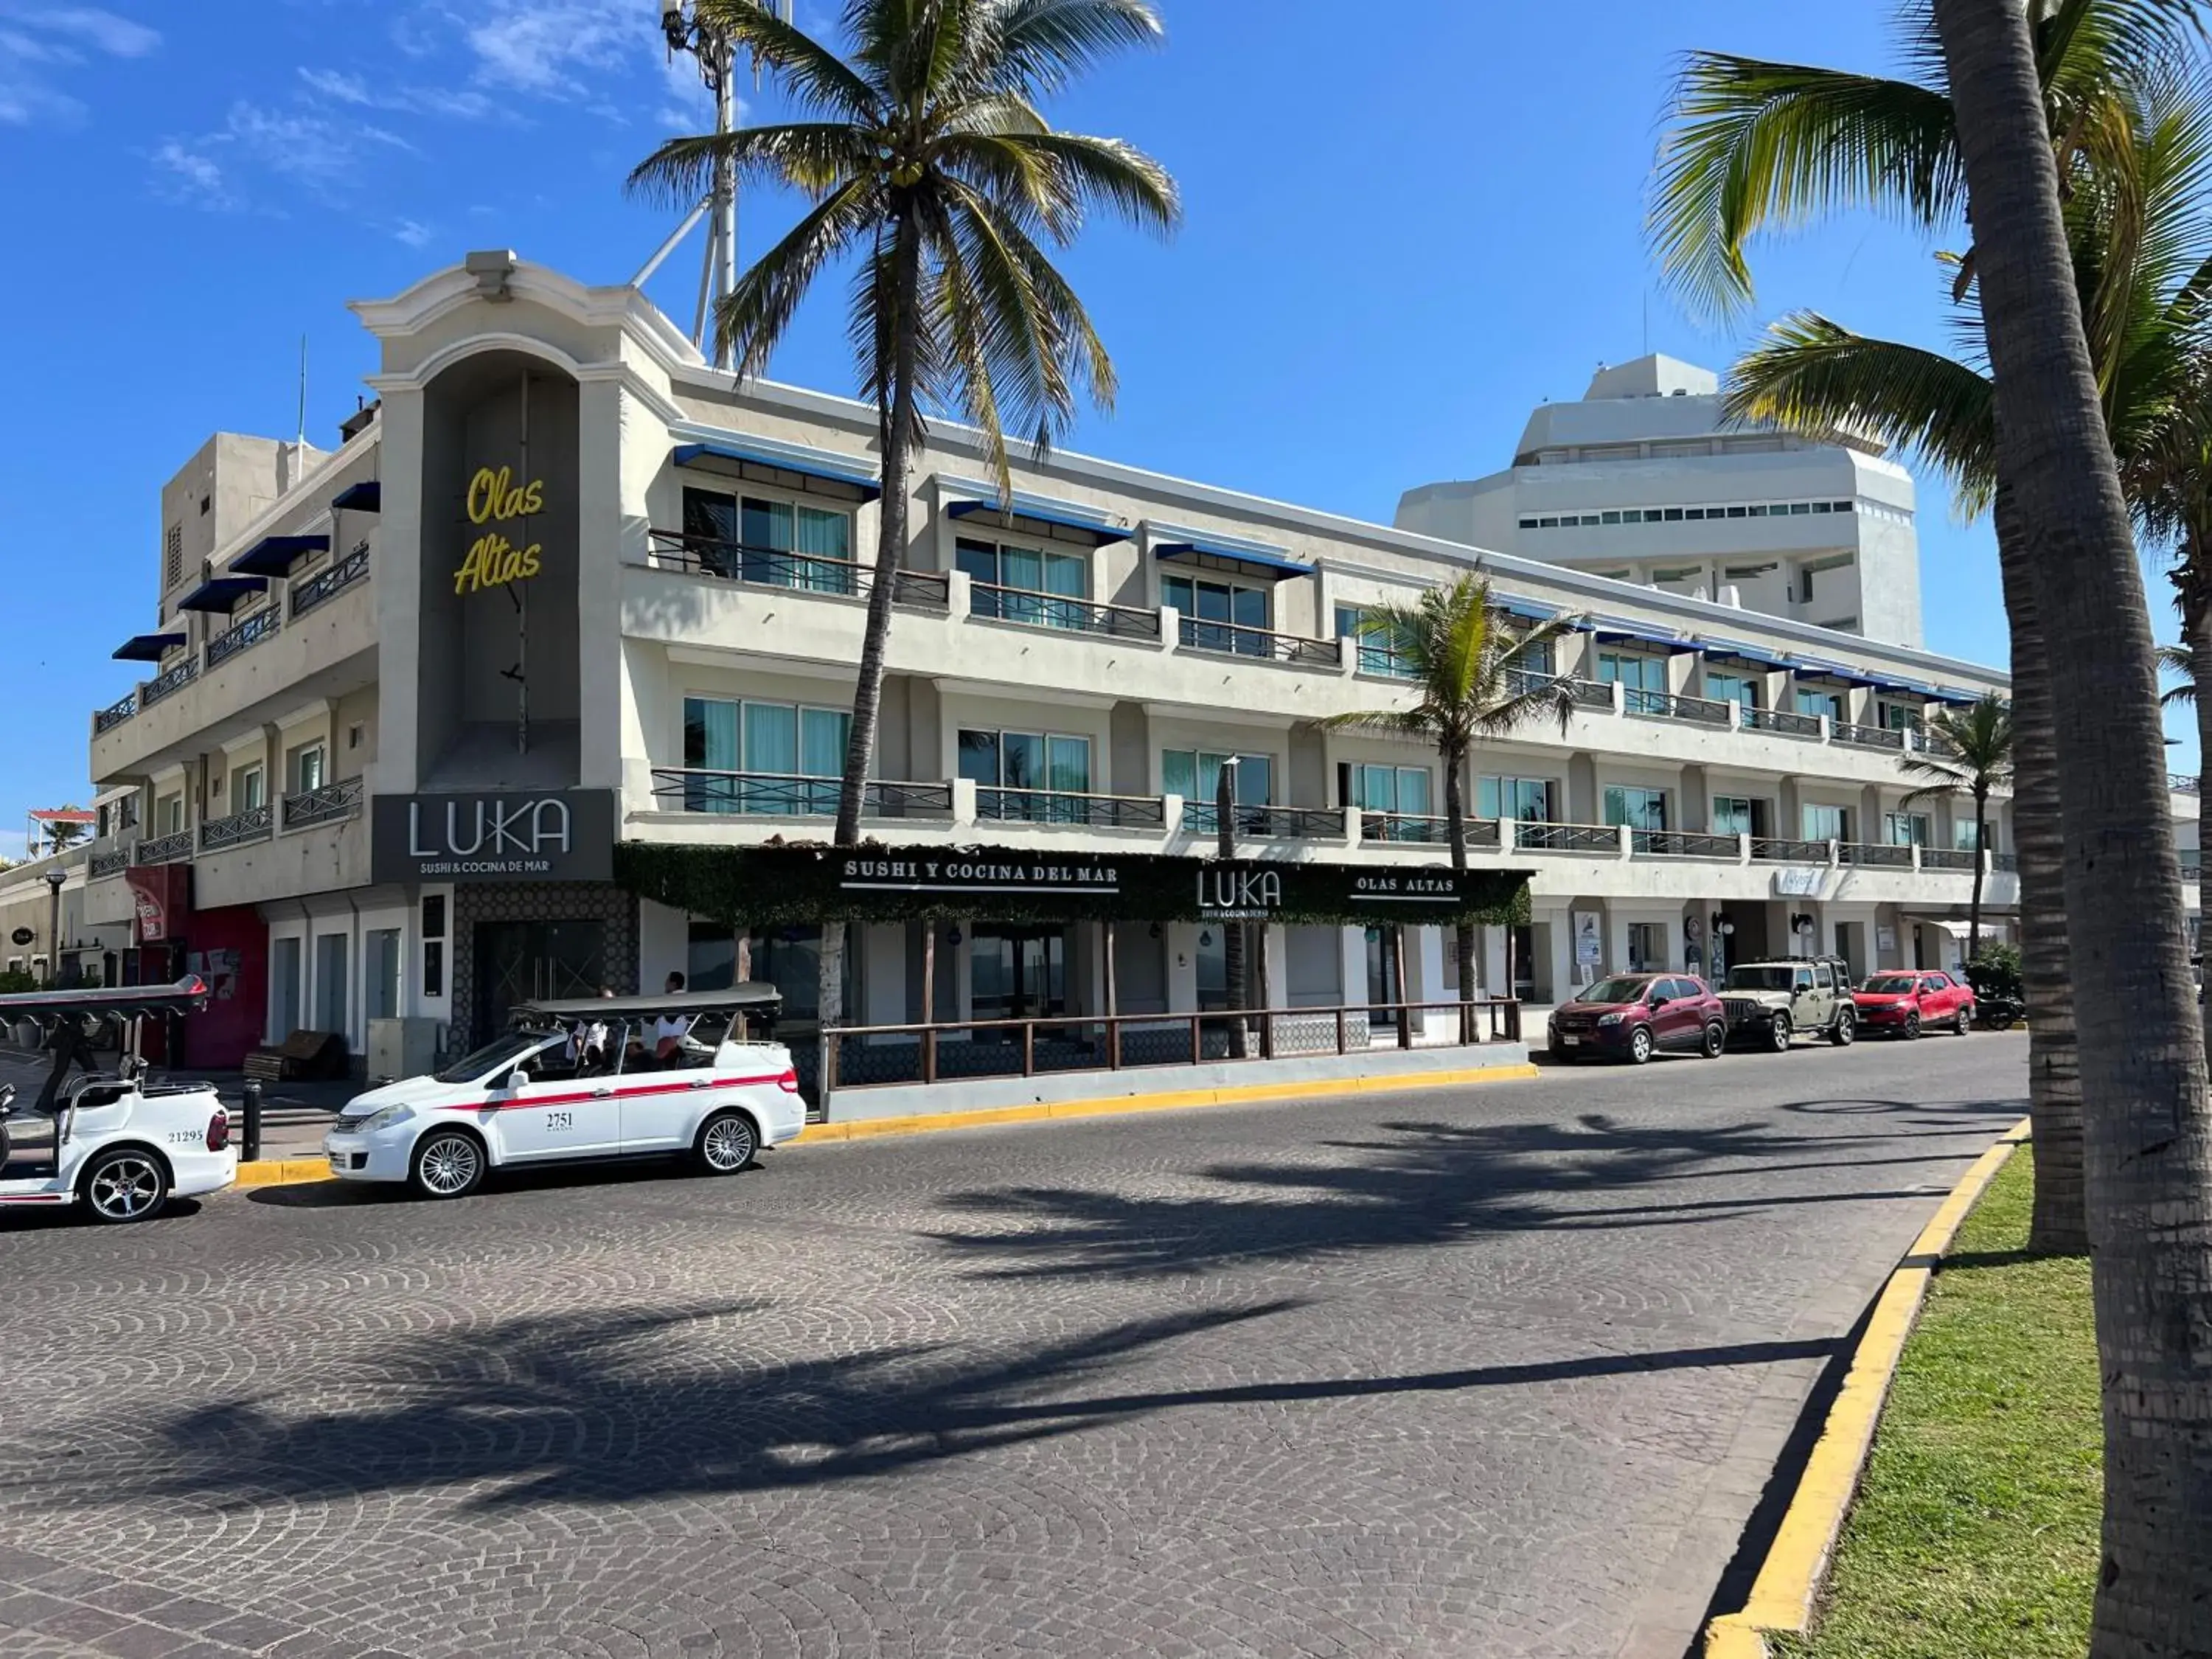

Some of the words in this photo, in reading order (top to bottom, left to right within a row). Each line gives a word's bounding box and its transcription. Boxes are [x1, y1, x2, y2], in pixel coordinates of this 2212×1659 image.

[467, 465, 544, 524] Olas
[453, 532, 542, 594] Altas
[409, 799, 571, 857] LUKA
[420, 863, 451, 874] SUSHI
[452, 863, 461, 873] &
[462, 861, 507, 873] COCINA
[508, 861, 522, 872] DE
[524, 860, 549, 872] MAR
[844, 861, 917, 877] SUSHI
[925, 863, 939, 877] Y
[945, 863, 1026, 880] COCINA
[1032, 866, 1071, 880] DEL
[1077, 867, 1118, 883] MAR
[1197, 870, 1281, 908] LUKA
[1356, 877, 1397, 890] OLAS
[1406, 879, 1454, 891] ALTAS
[547, 1112, 571, 1127] 2751
[167, 1130, 204, 1143] 21295
